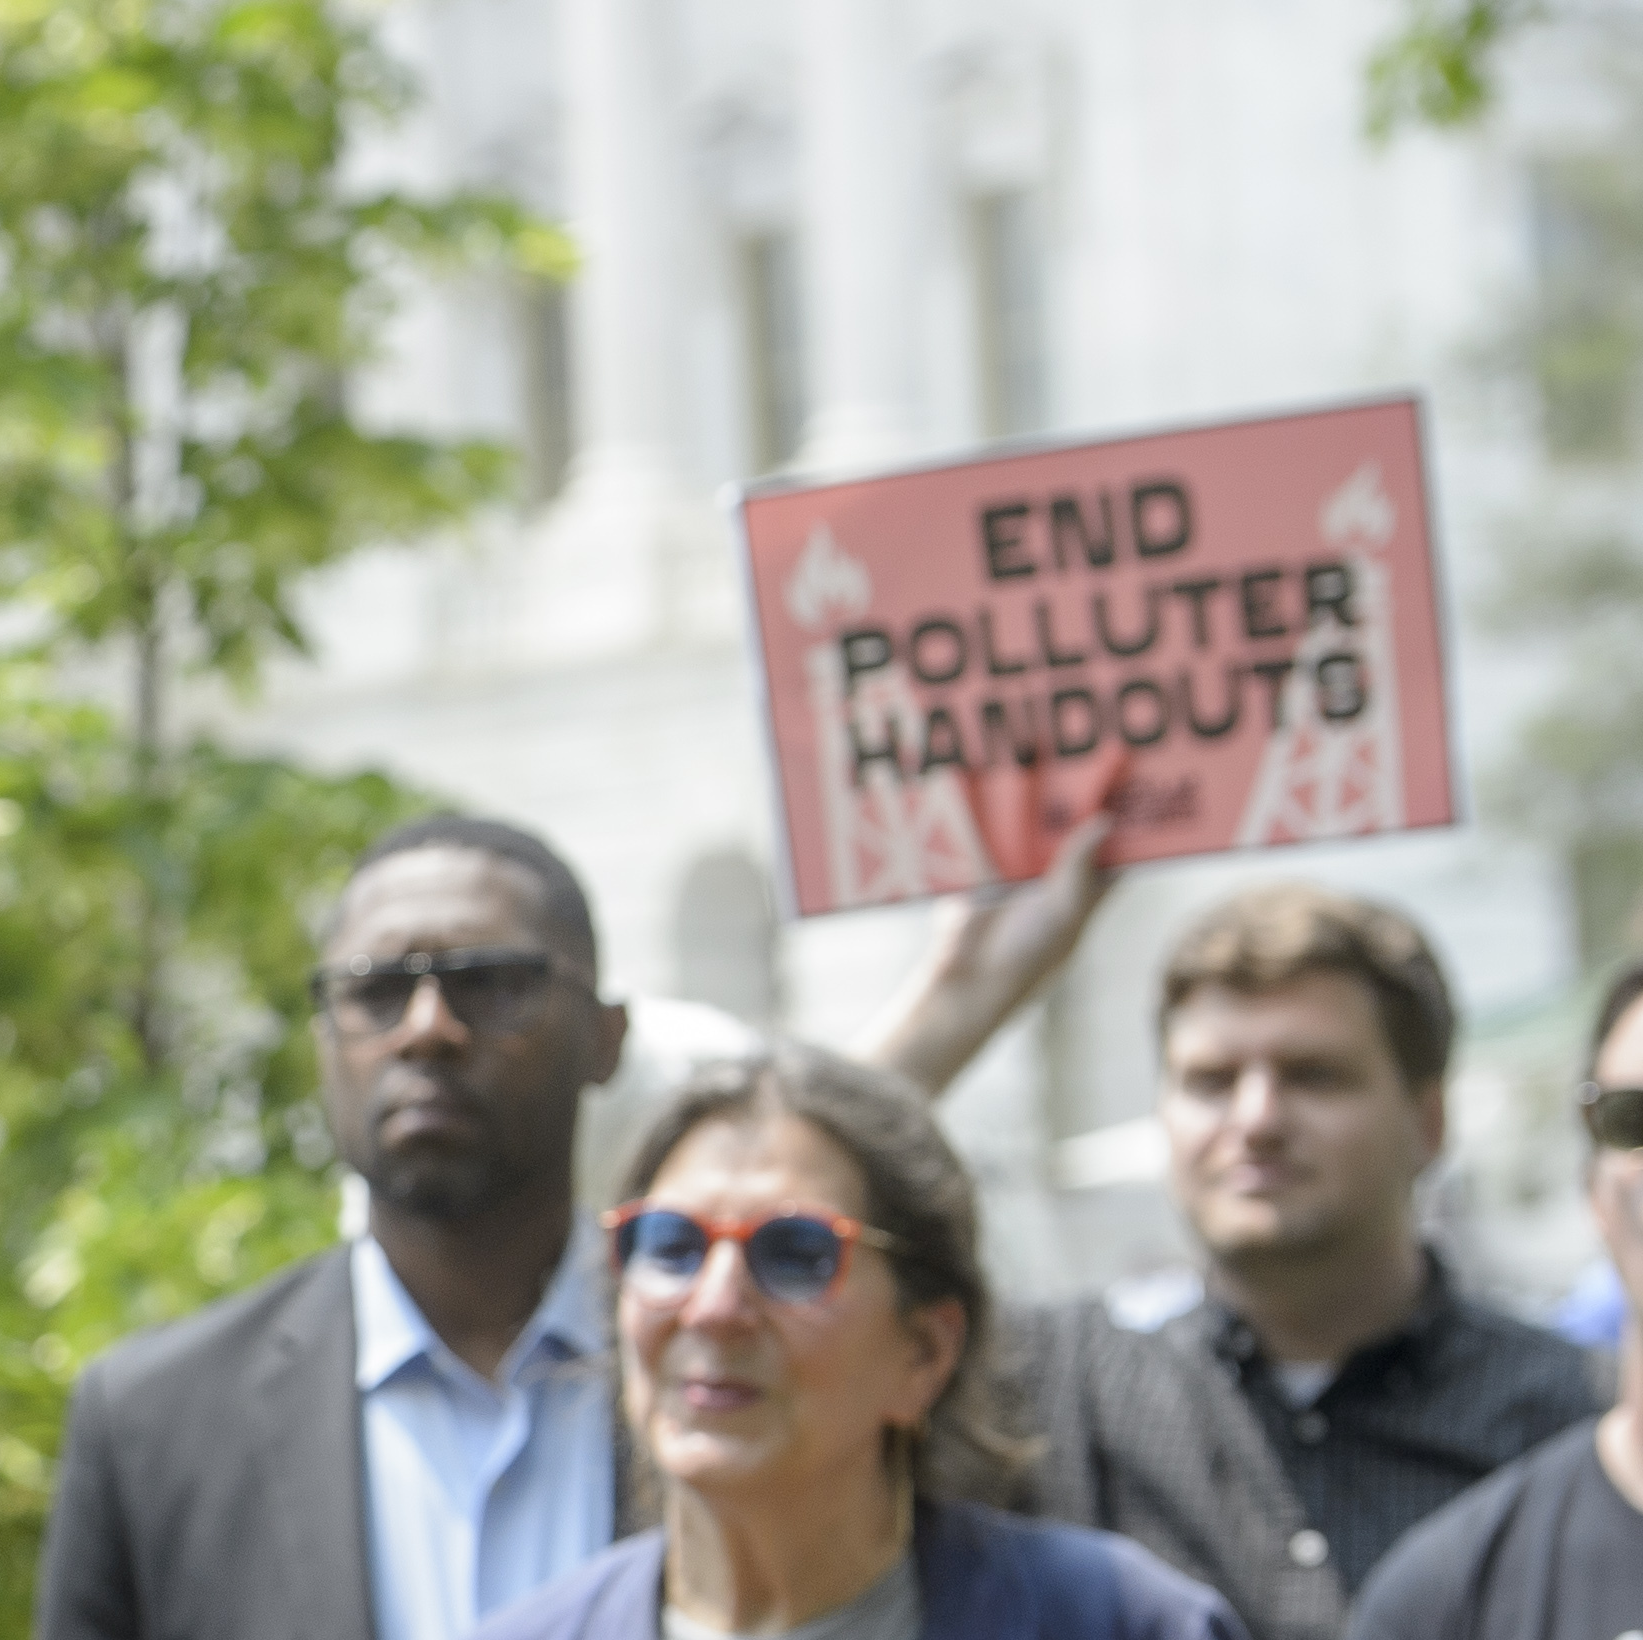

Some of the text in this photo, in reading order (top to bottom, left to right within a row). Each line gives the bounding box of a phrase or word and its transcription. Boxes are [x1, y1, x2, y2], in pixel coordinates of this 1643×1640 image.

[979, 477, 1194, 583] END
[841, 561, 1358, 690] POLLUTER
[850, 652, 1369, 786] HANDOUTS
